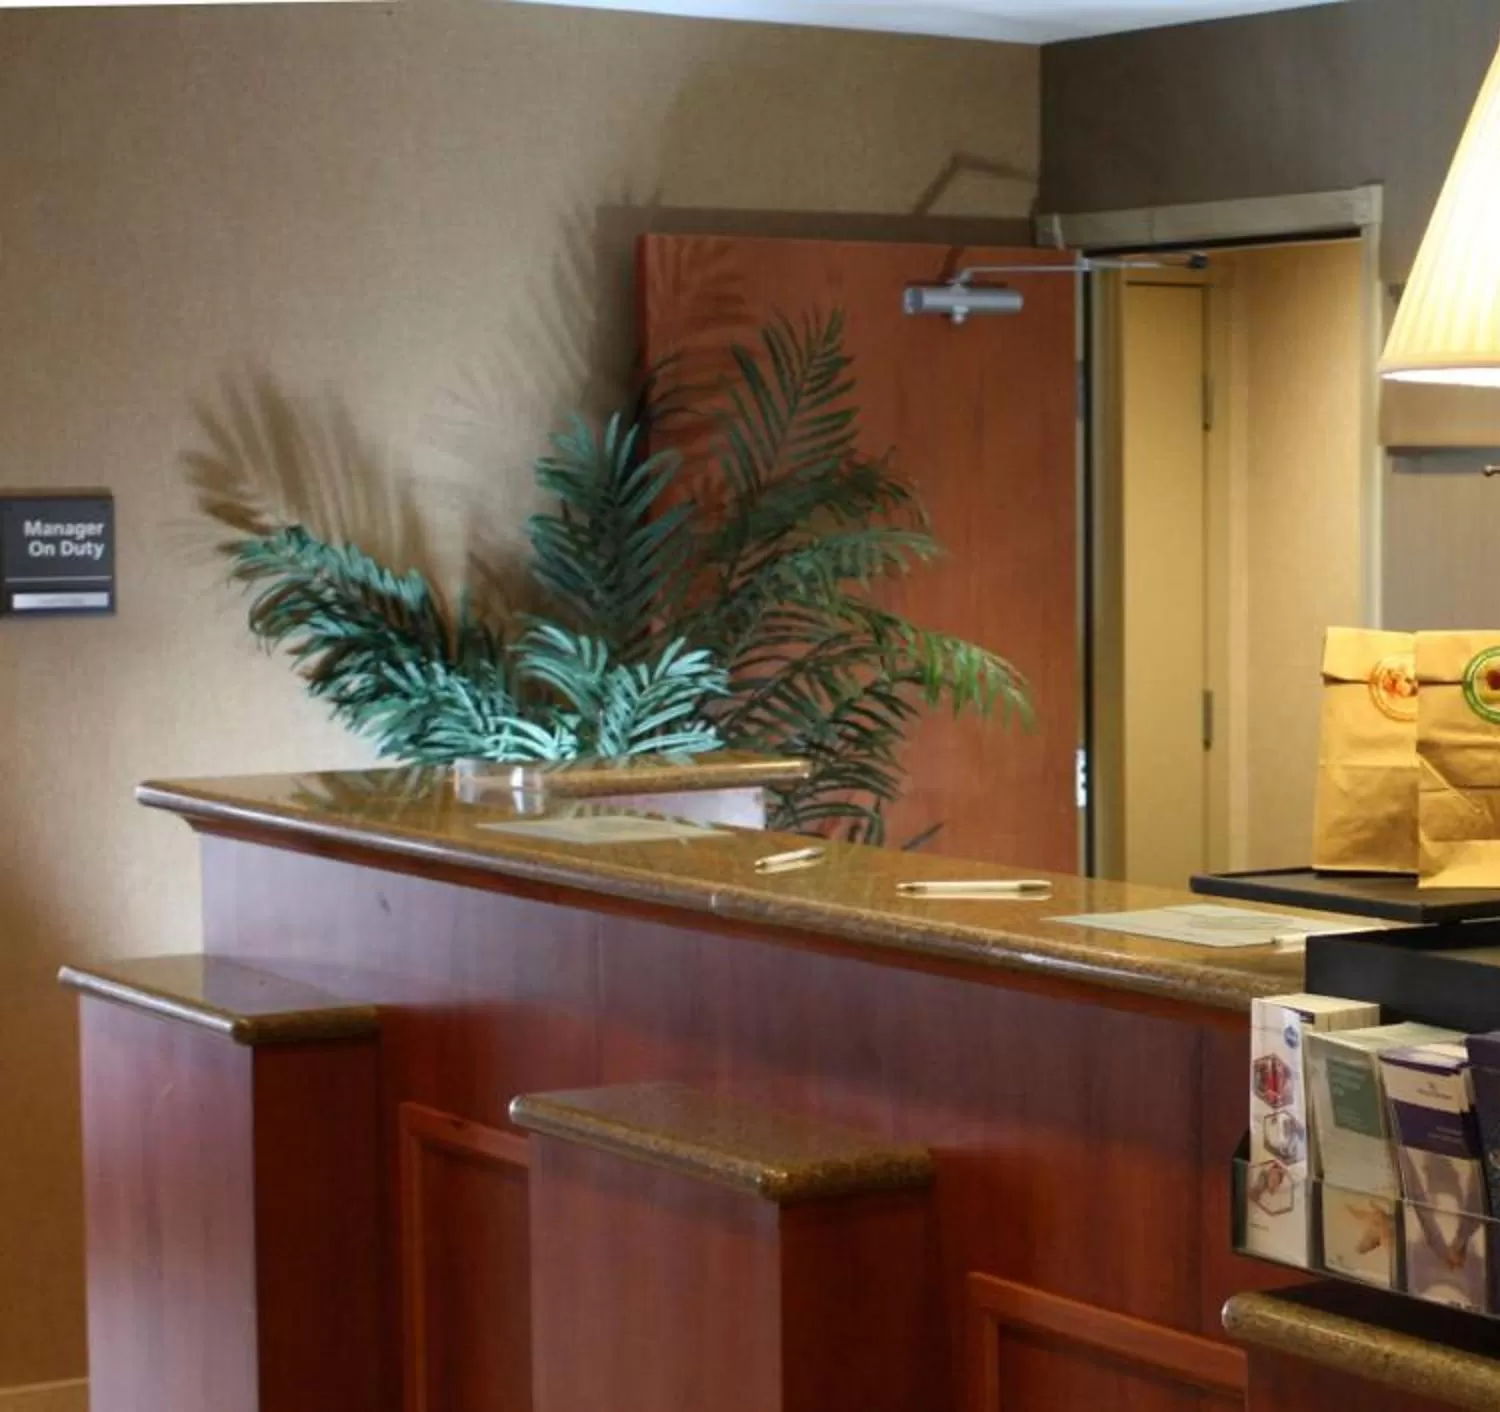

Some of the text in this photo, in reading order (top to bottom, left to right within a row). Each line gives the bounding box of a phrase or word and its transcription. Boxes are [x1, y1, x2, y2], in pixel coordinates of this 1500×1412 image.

[23, 520, 104, 540] Manager
[28, 540, 104, 560] On Duty
